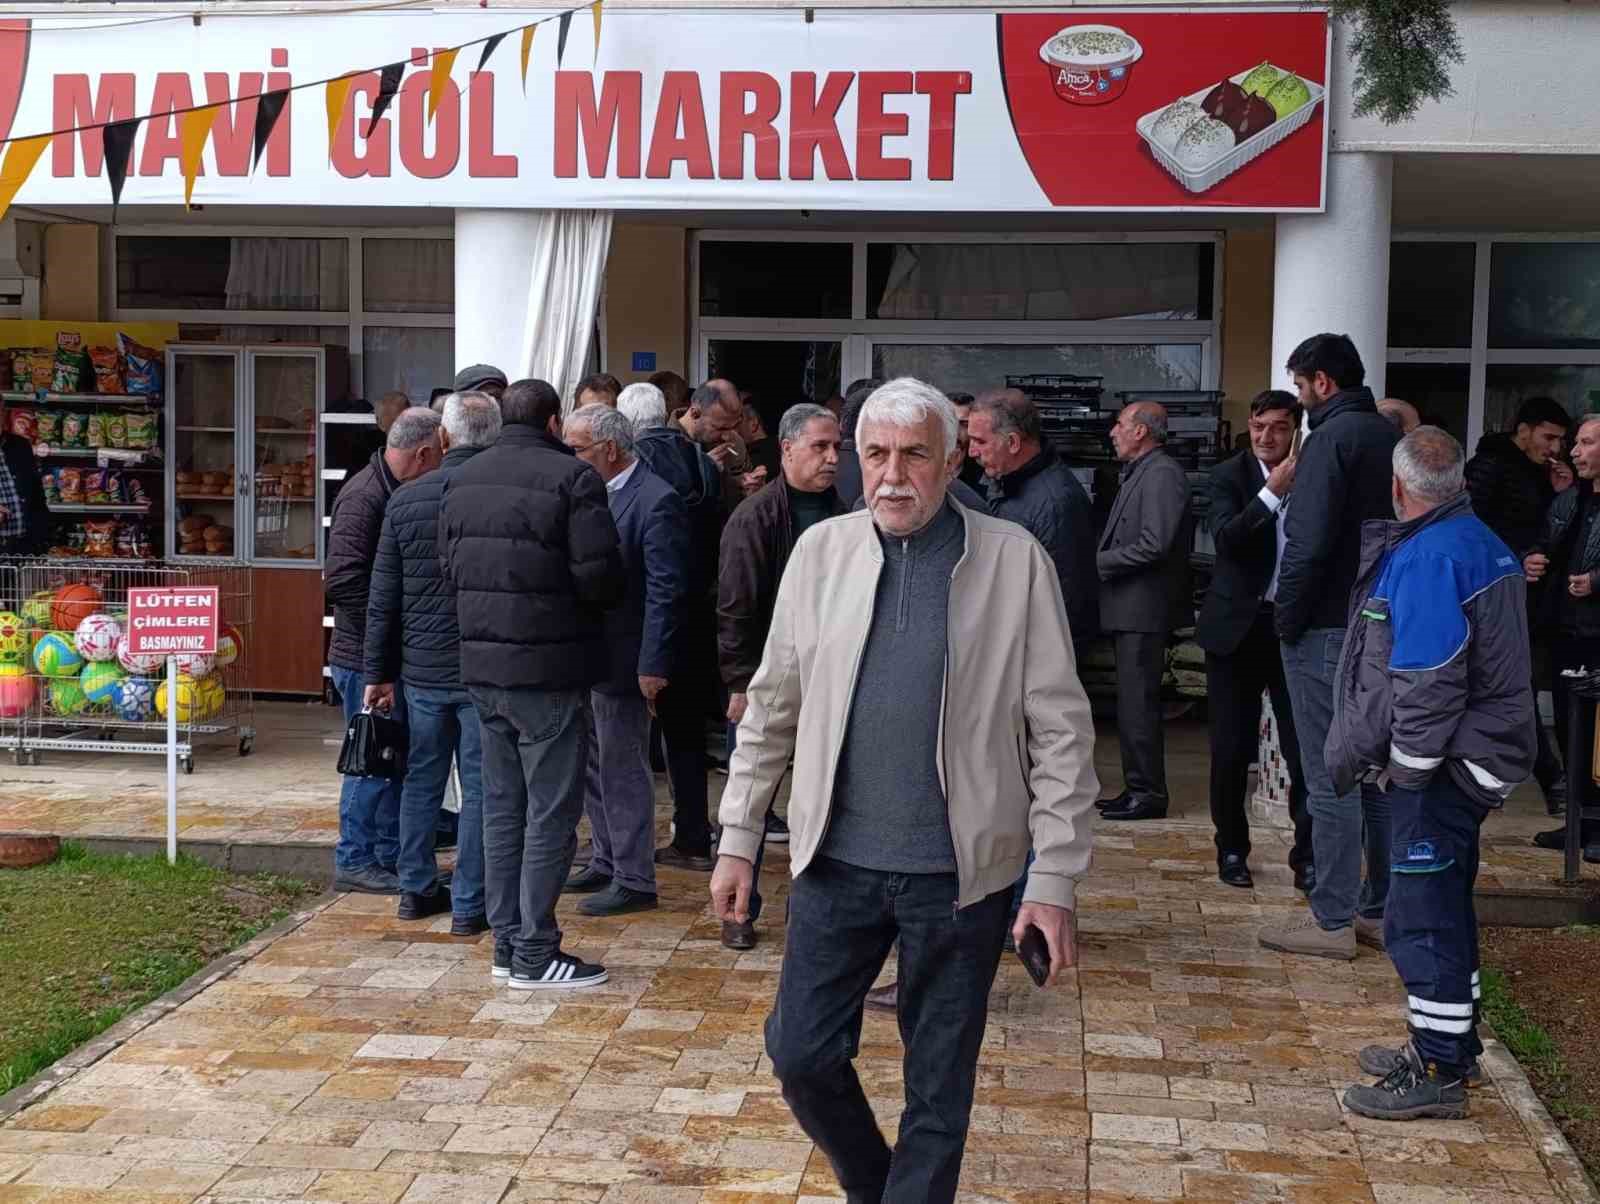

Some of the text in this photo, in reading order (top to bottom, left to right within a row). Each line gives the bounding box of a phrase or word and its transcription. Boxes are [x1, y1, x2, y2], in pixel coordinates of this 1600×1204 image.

[51, 47, 972, 181] MAVİ GÖL MARKET
[135, 594, 212, 608] LÜTFEN
[133, 615, 211, 630] ÇİMLERE
[140, 636, 205, 650] BASMAYINIZ
